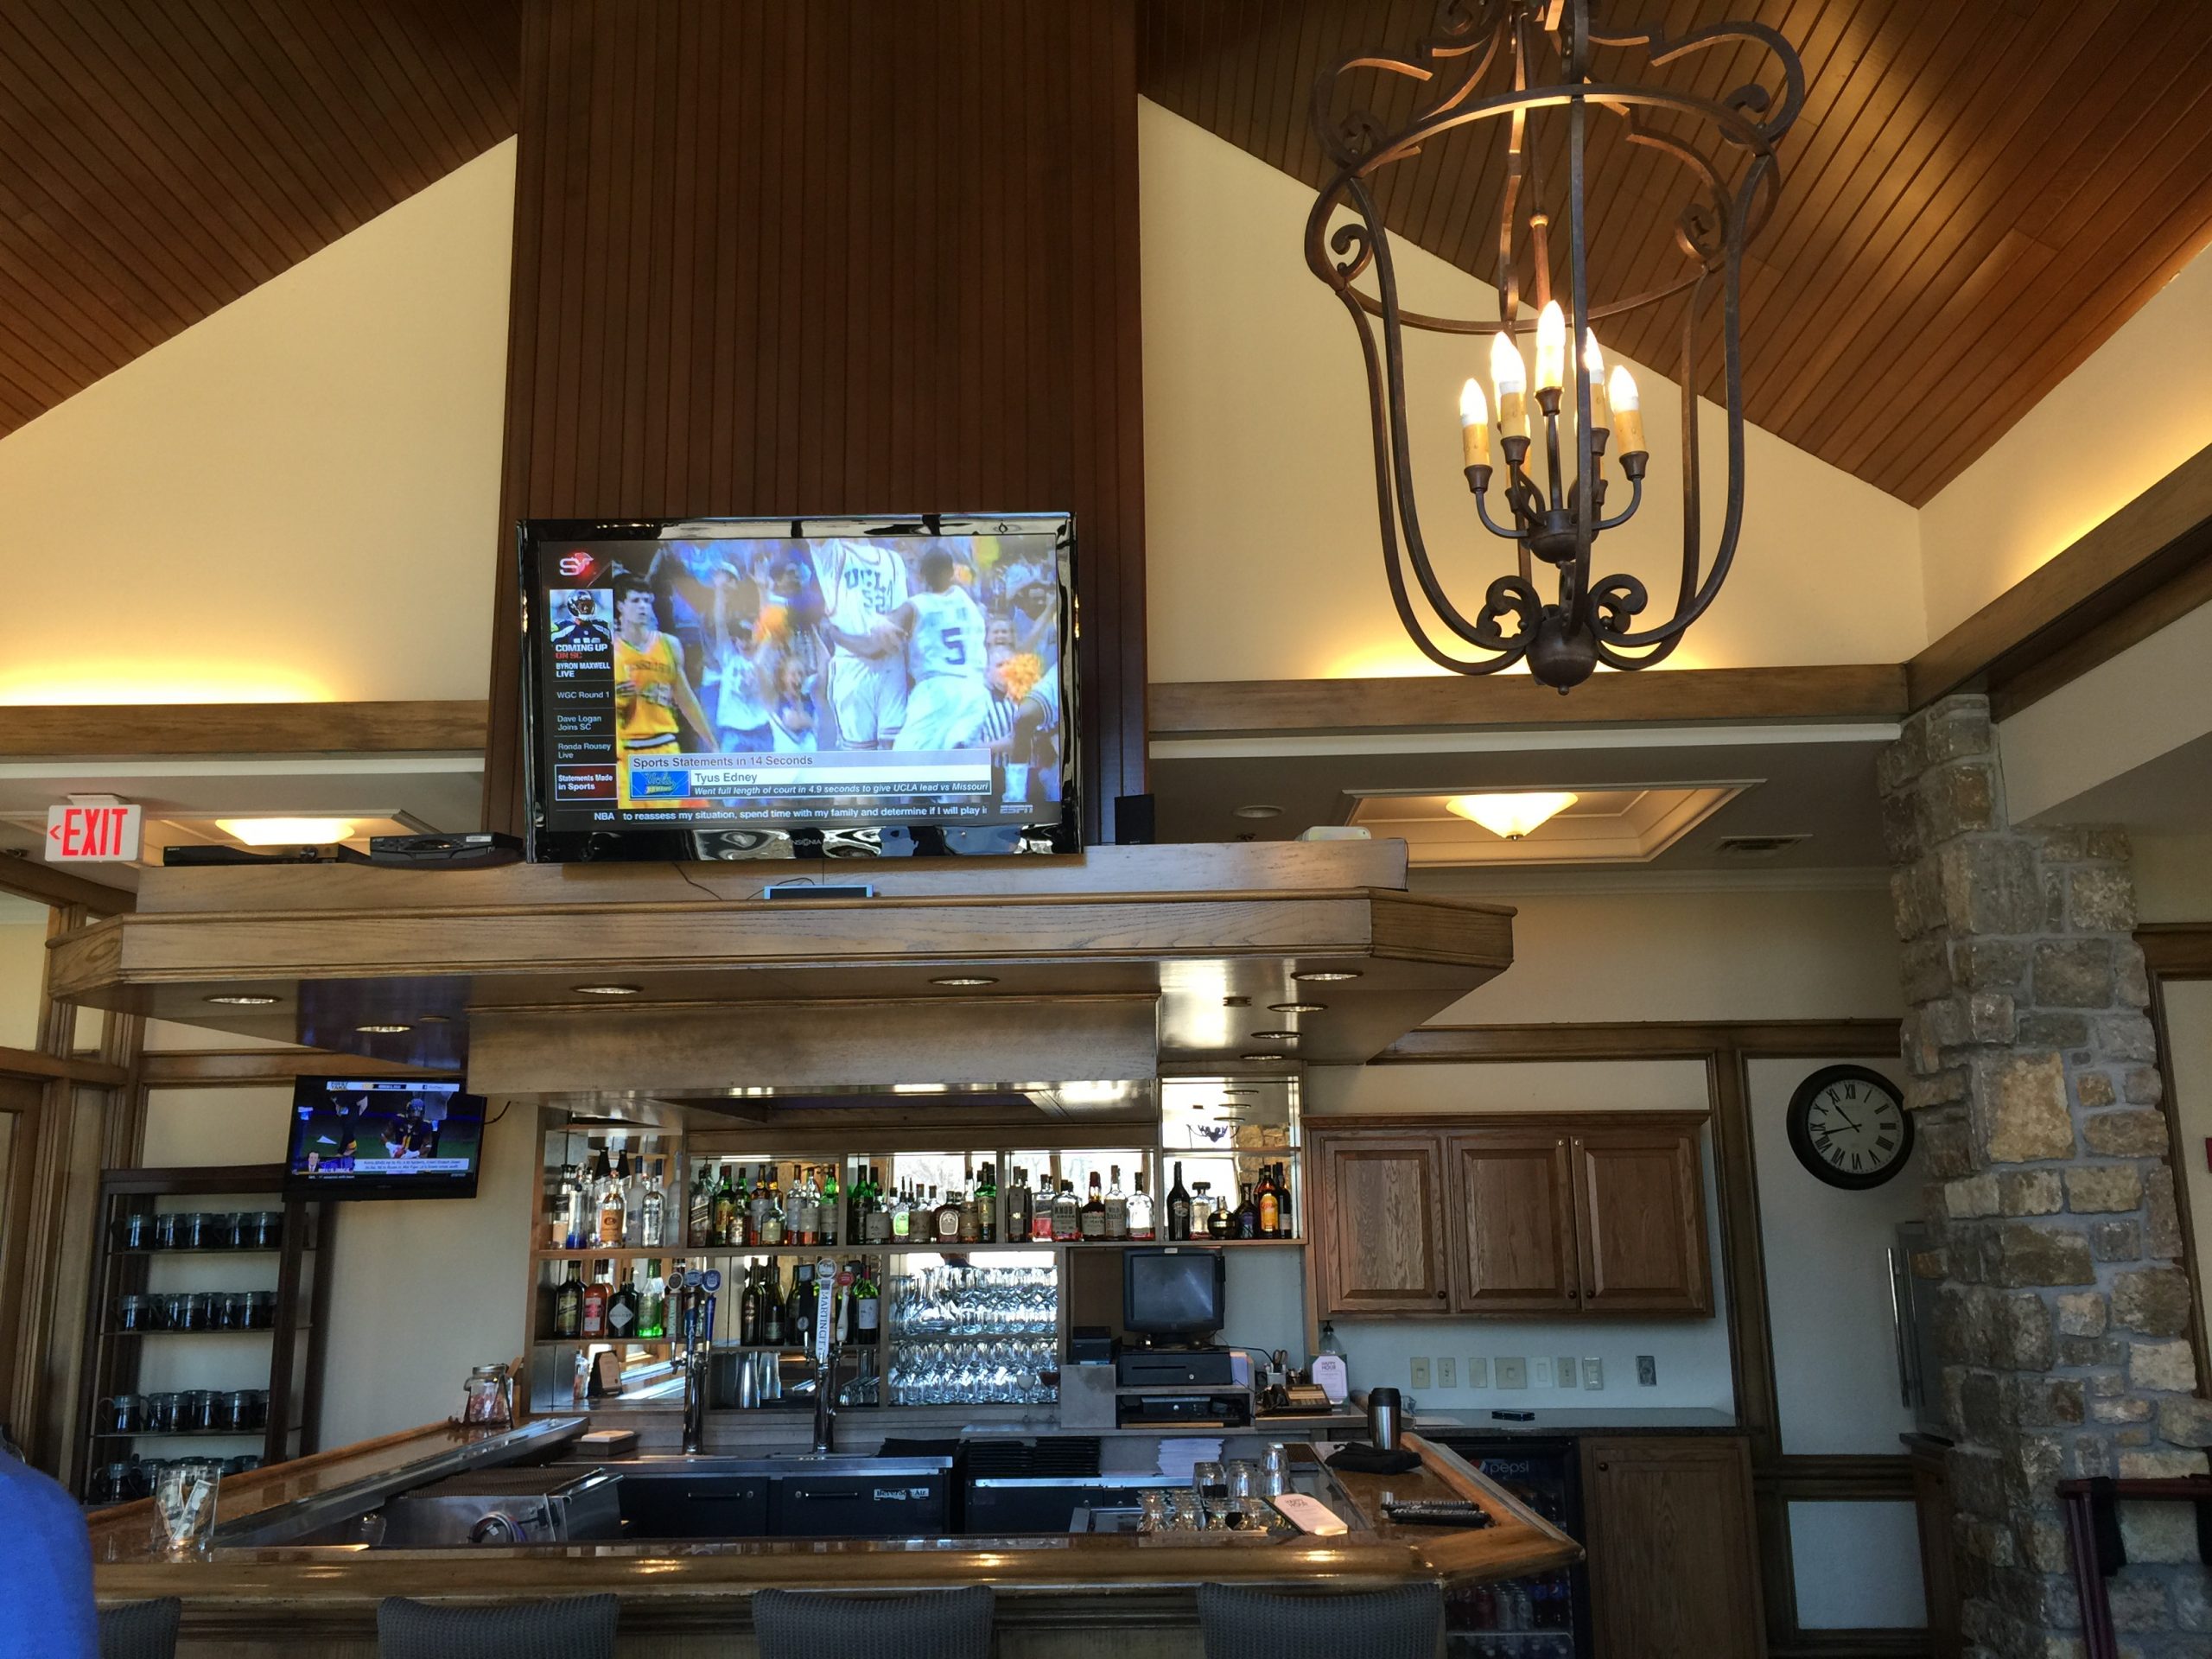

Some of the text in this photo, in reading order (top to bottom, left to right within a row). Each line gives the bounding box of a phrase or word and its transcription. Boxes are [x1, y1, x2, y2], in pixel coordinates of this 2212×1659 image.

[556, 643, 608, 652] COMING UP
[941, 627, 966, 665] 5
[578, 715, 602, 723] Logan
[583, 742, 612, 752] Rousey
[633, 755, 813, 769] Sports Statements in 14 Seconds
[695, 772, 758, 785] Tyus Edney
[568, 782, 595, 791] Sports
[717, 786, 731, 795] full
[734, 786, 760, 797] length
[762, 785, 772, 794] of
[809, 785, 823, 793] 4.9
[823, 784, 860, 793] seconds
[862, 784, 871, 792] to
[873, 784, 891, 794] give
[893, 783, 918, 791] UCLA
[919, 783, 938, 791] lead
[951, 782, 988, 791] Missouri
[594, 812, 614, 821] NBA
[678, 813, 693, 822] my
[695, 811, 737, 820] situation,
[740, 810, 768, 821] spend
[771, 810, 791, 818] time
[792, 809, 813, 817] with
[814, 810, 829, 818] my
[830, 808, 859, 818] family
[861, 808, 879, 817] and
[880, 807, 927, 817] determine
[929, 806, 936, 815] if
[943, 806, 958, 815] will
[961, 806, 981, 817] play
[1000, 805, 1033, 815] ESPN
[62, 808, 129, 856] EXIT
[1490, 1460, 1529, 1476] pepsi
